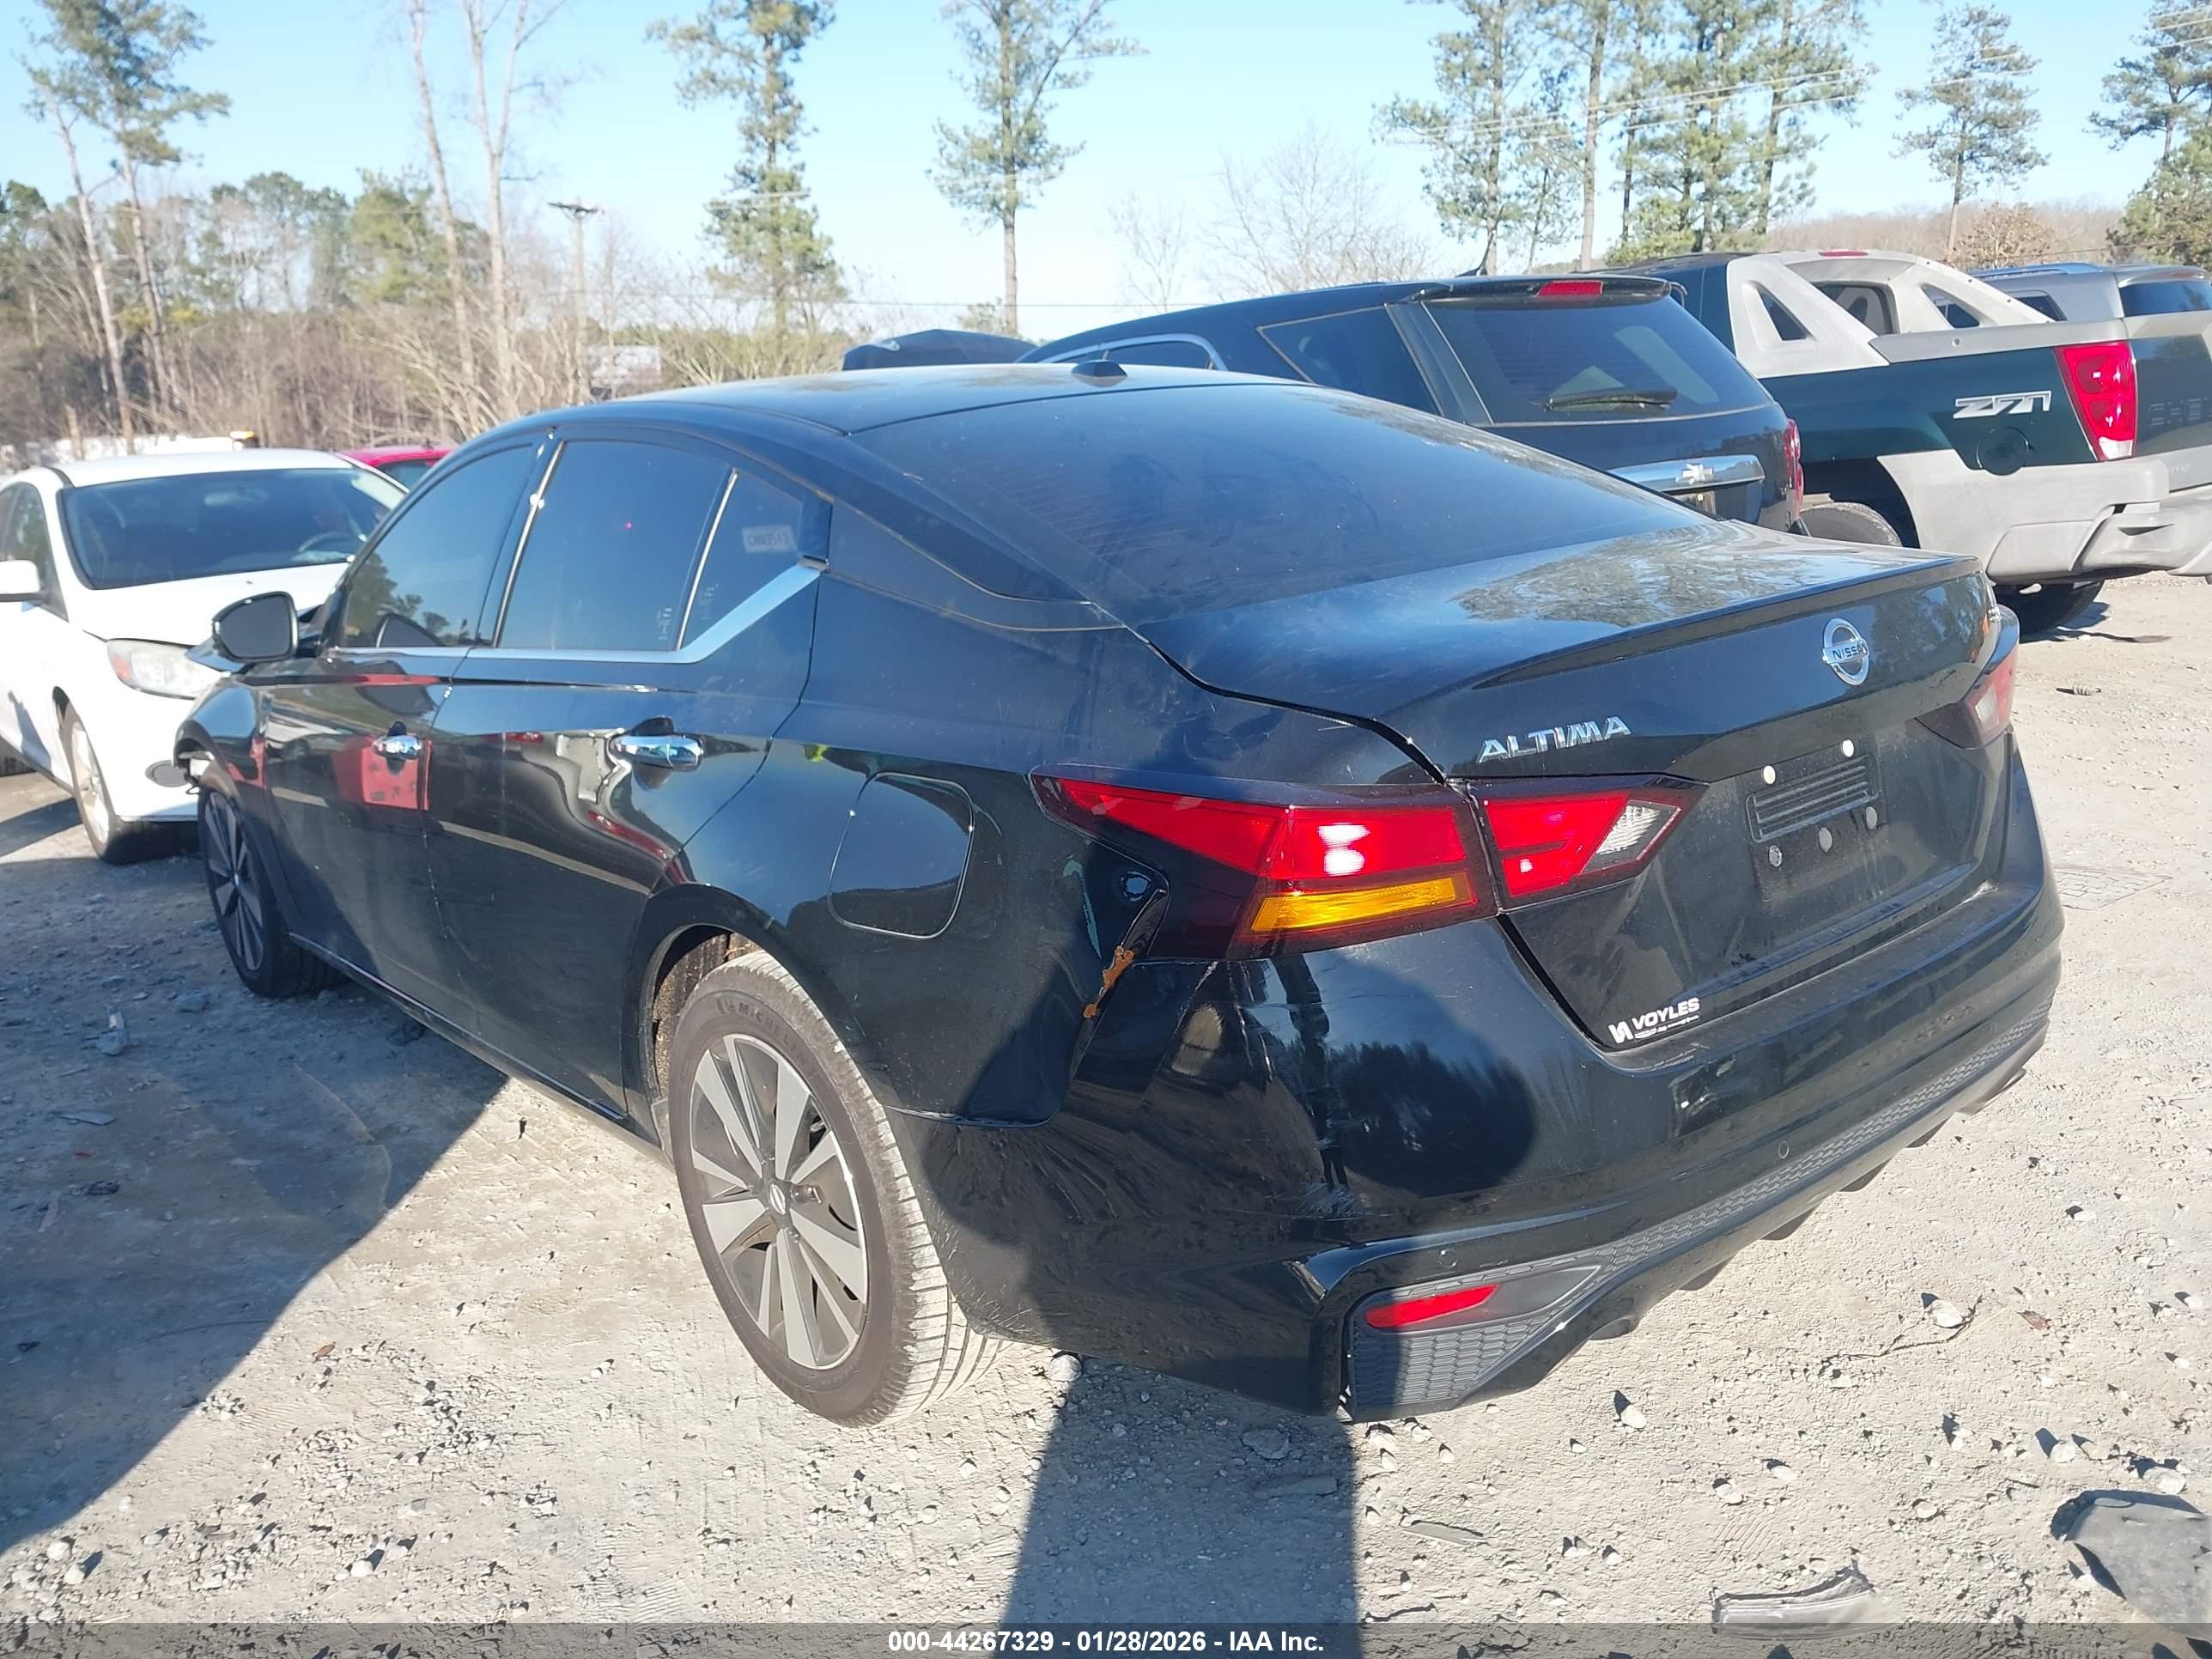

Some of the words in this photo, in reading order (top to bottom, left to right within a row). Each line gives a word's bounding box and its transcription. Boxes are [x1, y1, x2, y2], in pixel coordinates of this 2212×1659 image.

[1832, 643, 1869, 660] NISSAN
[1477, 715, 1632, 763] ALTIMA
[738, 1002, 805, 1060] MICHELIN
[1632, 997, 1700, 1030] VOYLES
